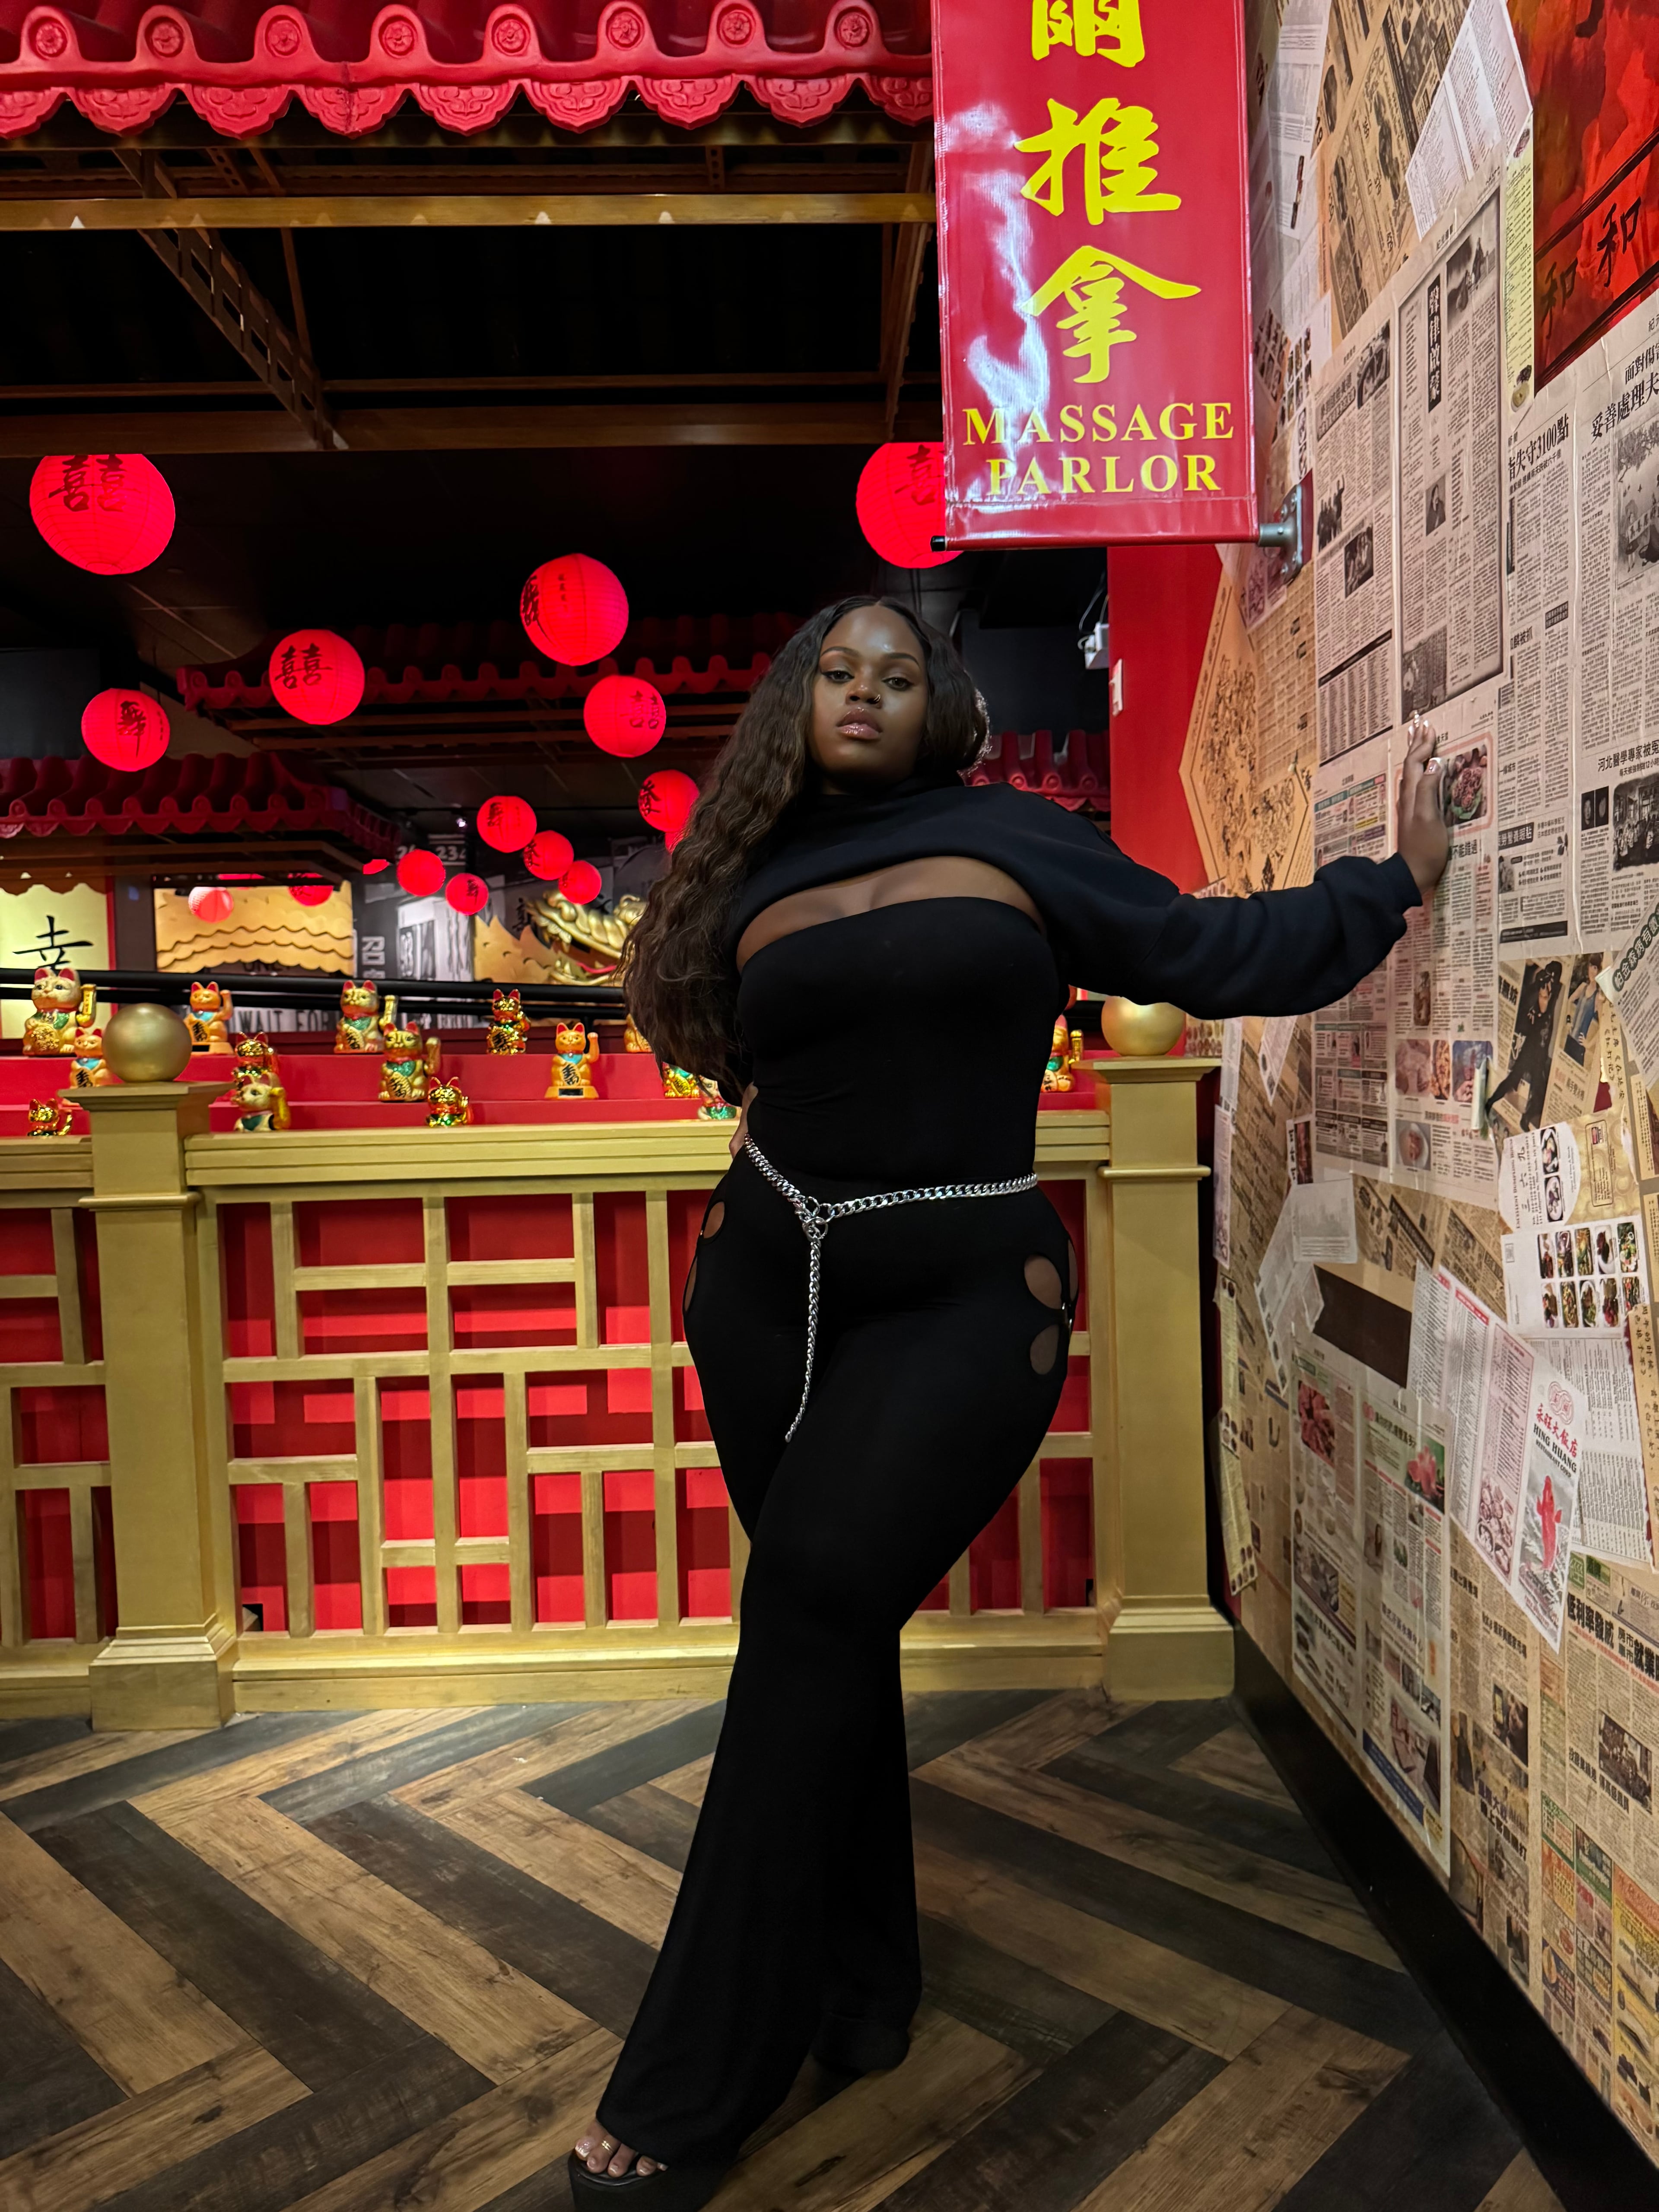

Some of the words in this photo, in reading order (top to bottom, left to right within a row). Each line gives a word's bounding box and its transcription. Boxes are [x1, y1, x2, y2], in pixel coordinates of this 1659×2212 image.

[963, 402, 1234, 446] MASSAGE
[986, 454, 1221, 495] PARLOR
[1533, 1423, 1550, 1447] HING
[1551, 1441, 1577, 1474] HUANG
